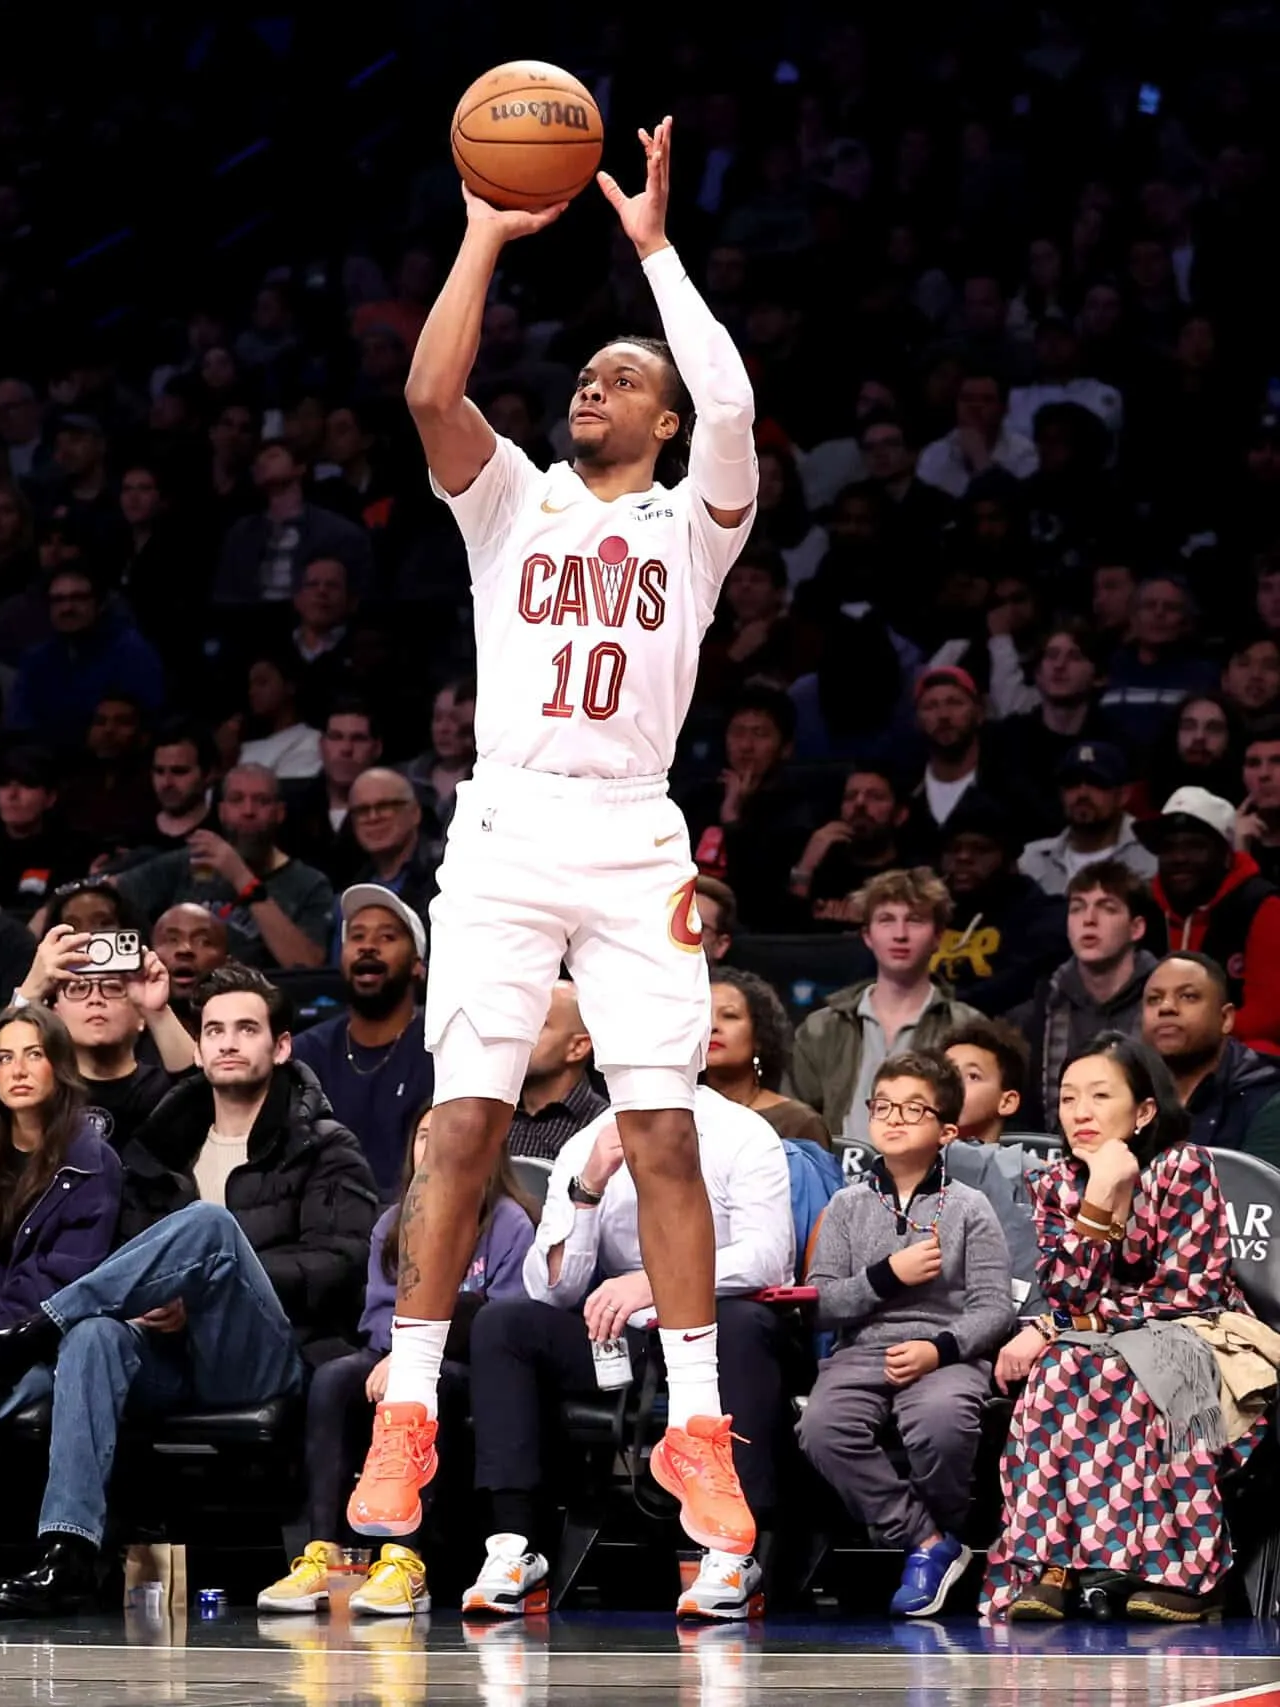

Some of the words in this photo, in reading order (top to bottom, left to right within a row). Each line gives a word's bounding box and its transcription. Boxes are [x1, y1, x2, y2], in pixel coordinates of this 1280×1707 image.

[491, 101, 589, 131] Wilson
[631, 508, 674, 521] LIFFS
[518, 552, 667, 631] CAVS
[541, 641, 627, 720] 10
